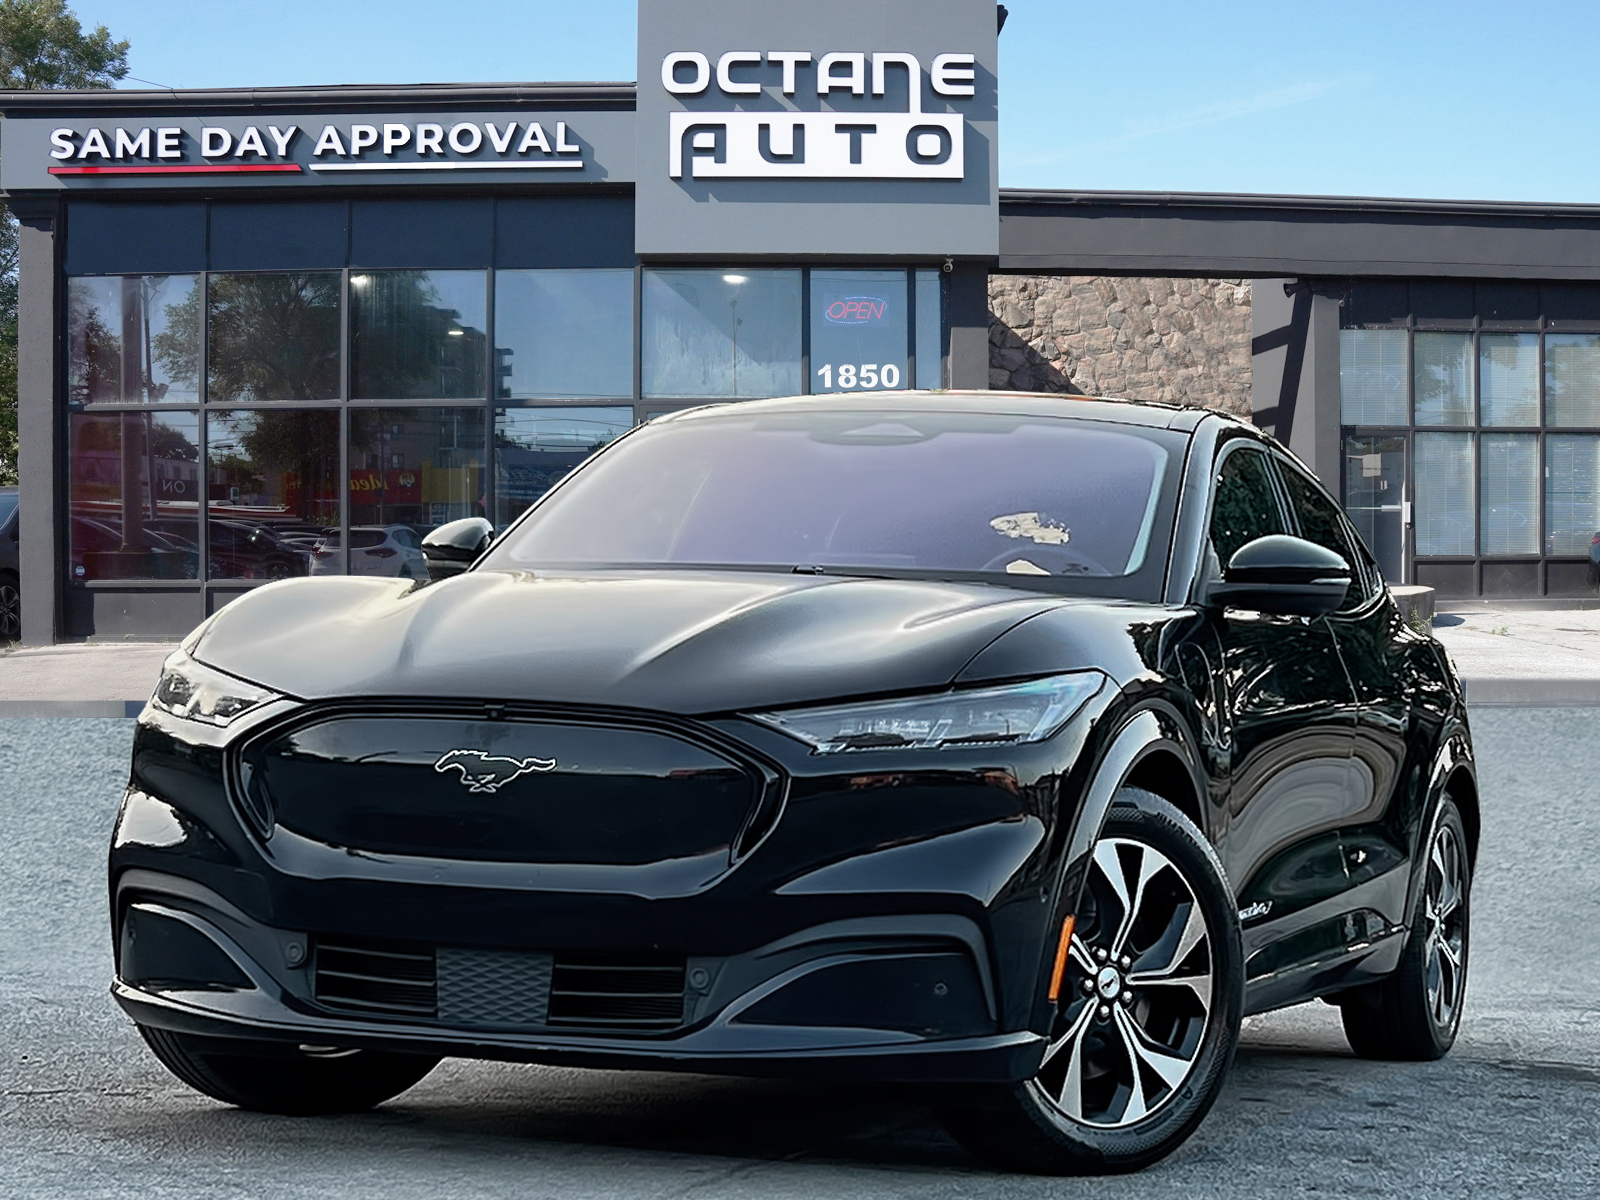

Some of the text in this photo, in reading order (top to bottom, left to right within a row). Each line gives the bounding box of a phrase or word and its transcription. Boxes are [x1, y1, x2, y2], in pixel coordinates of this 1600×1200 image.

[661, 51, 975, 96] OCTANE
[48, 121, 580, 160] SAME DAY APPROVAL
[680, 122, 953, 177] AUTO
[828, 301, 885, 320] OPEN
[817, 363, 900, 388] 1850
